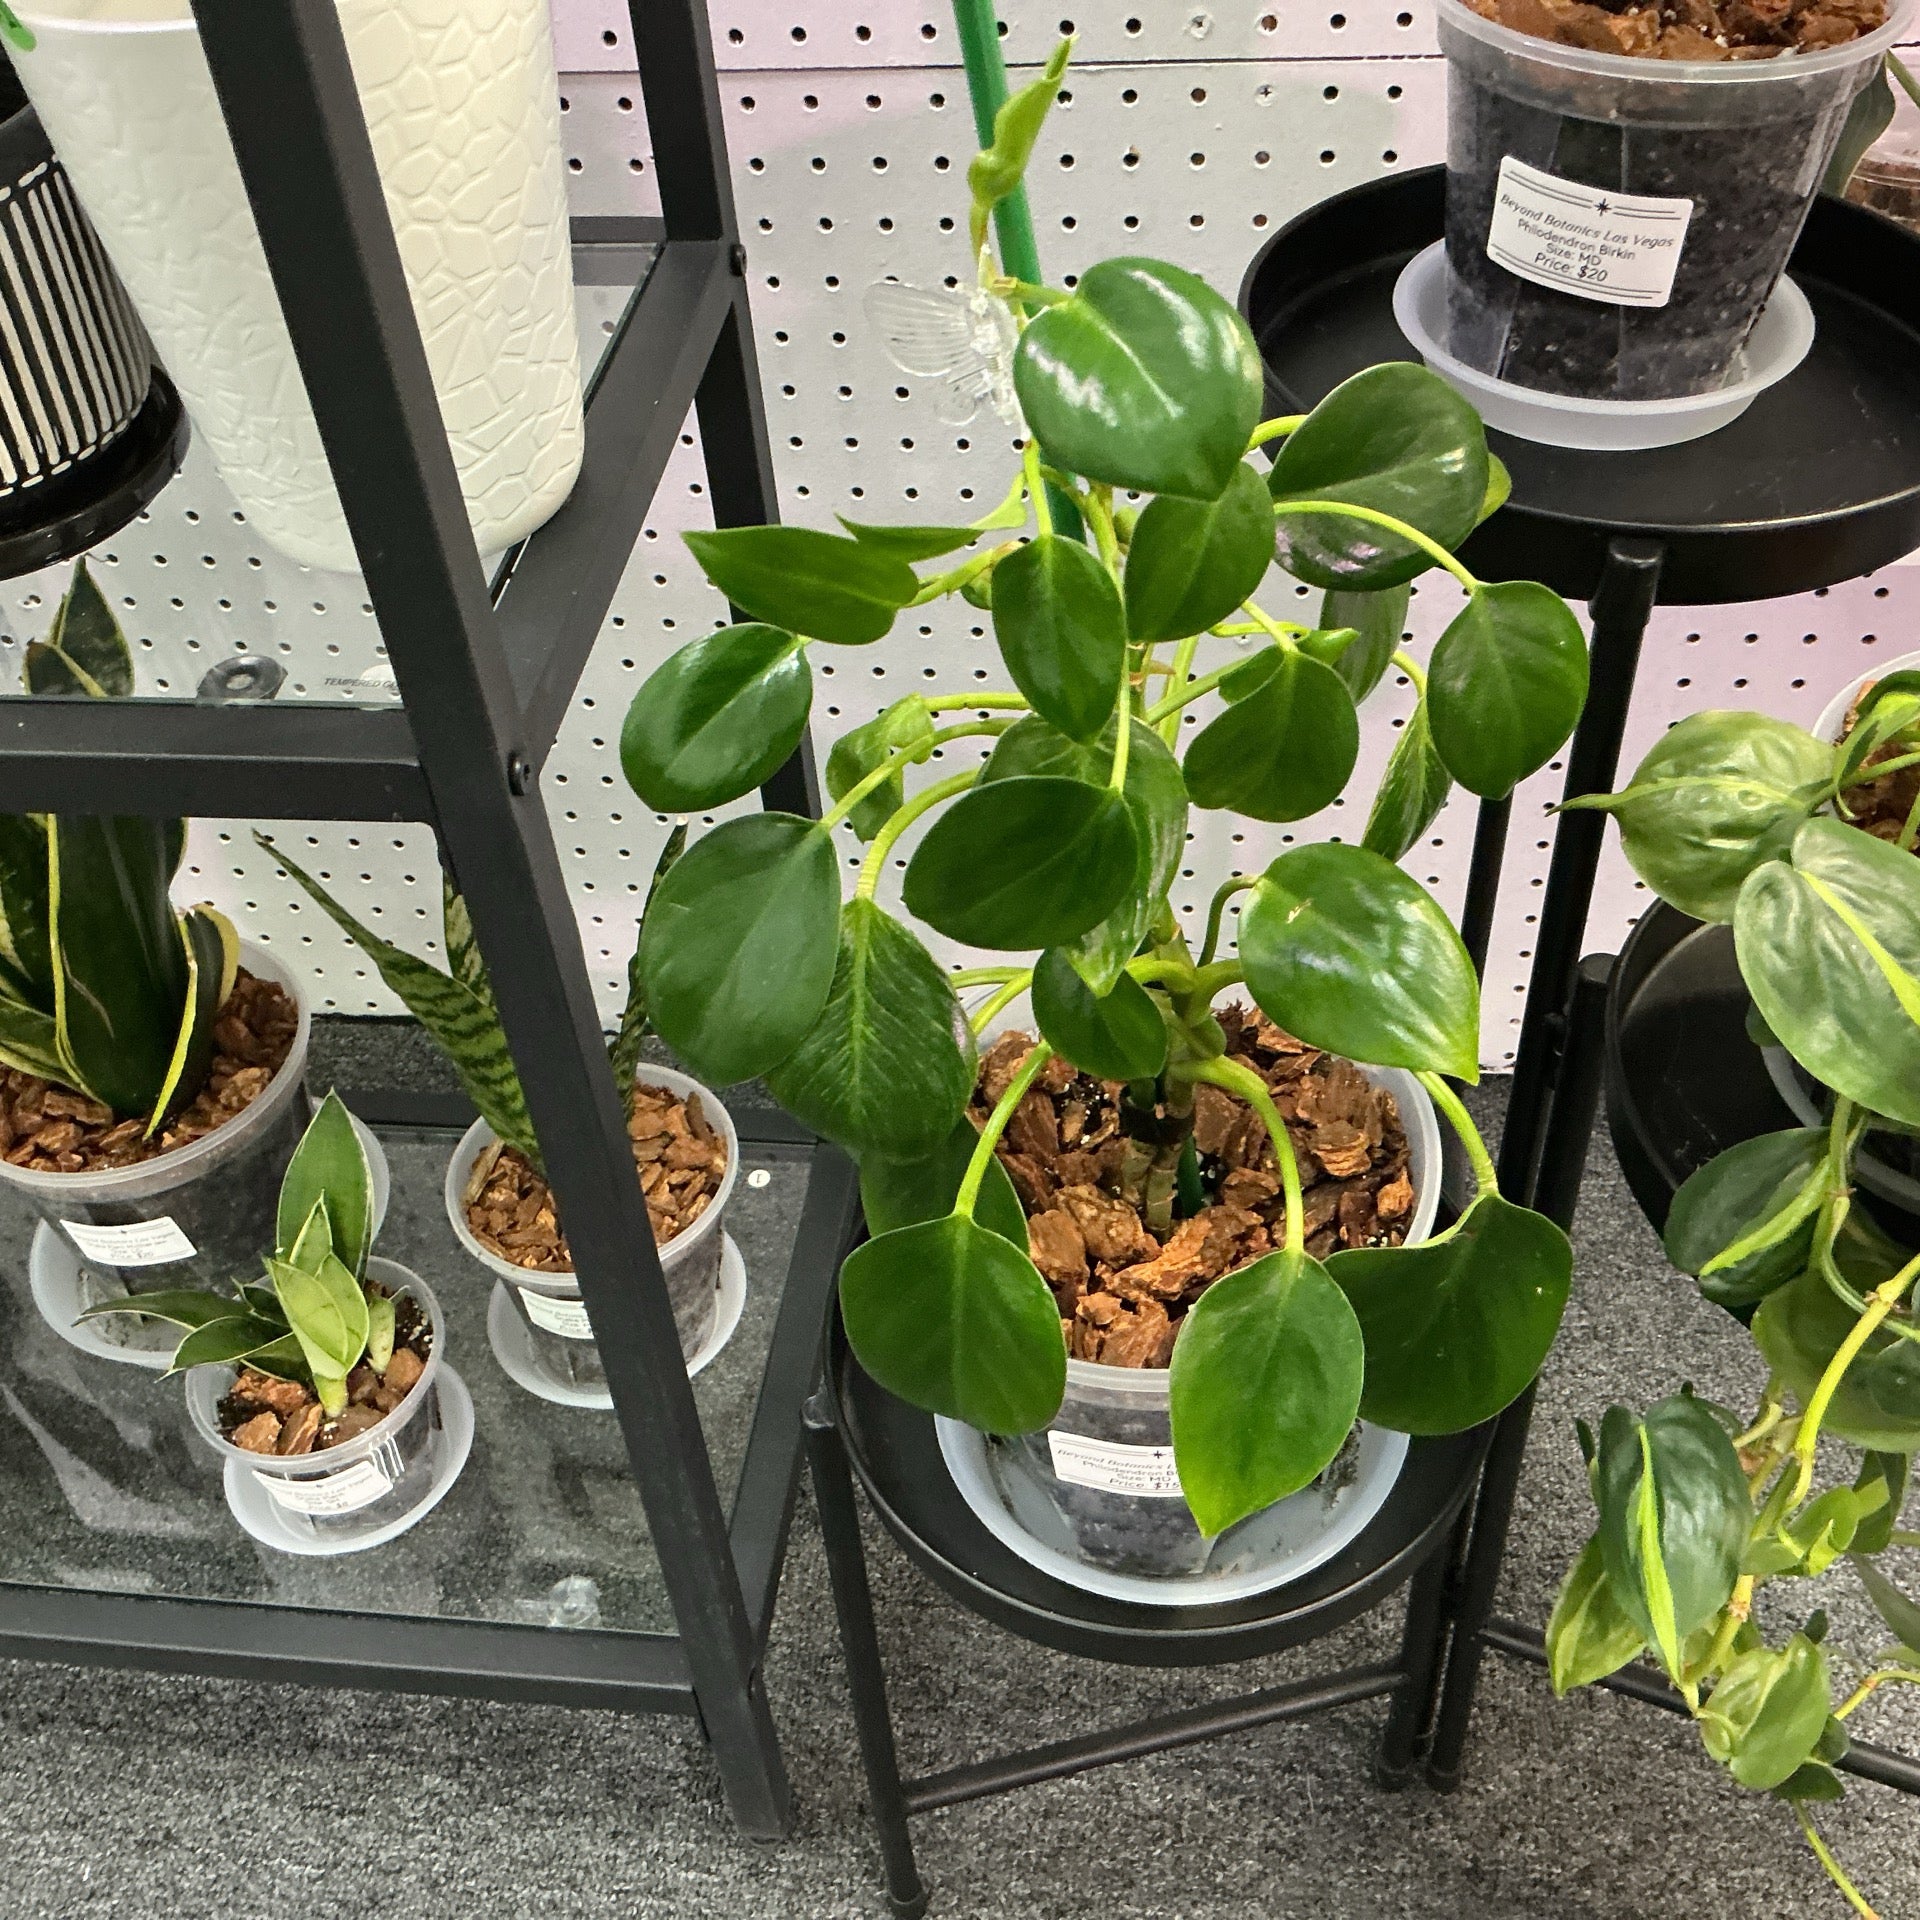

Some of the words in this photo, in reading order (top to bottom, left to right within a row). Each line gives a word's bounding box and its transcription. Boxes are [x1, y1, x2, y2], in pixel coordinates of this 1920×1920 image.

[1500, 194, 1543, 221] Beyond
[1543, 215, 1601, 239] Botanics
[1603, 230, 1627, 244] Las
[1633, 235, 1674, 250] Vegas
[1518, 218, 1595, 252] Philodendron
[1600, 244, 1636, 260] Birkin
[1534, 252, 1574, 273] Price:
[1577, 265, 1608, 282] $20
[1546, 243, 1574, 260] Size:
[1578, 254, 1602, 266] MD
[324, 677, 382, 688] TEMPERED
[1107, 1459, 1163, 1470] Botanics
